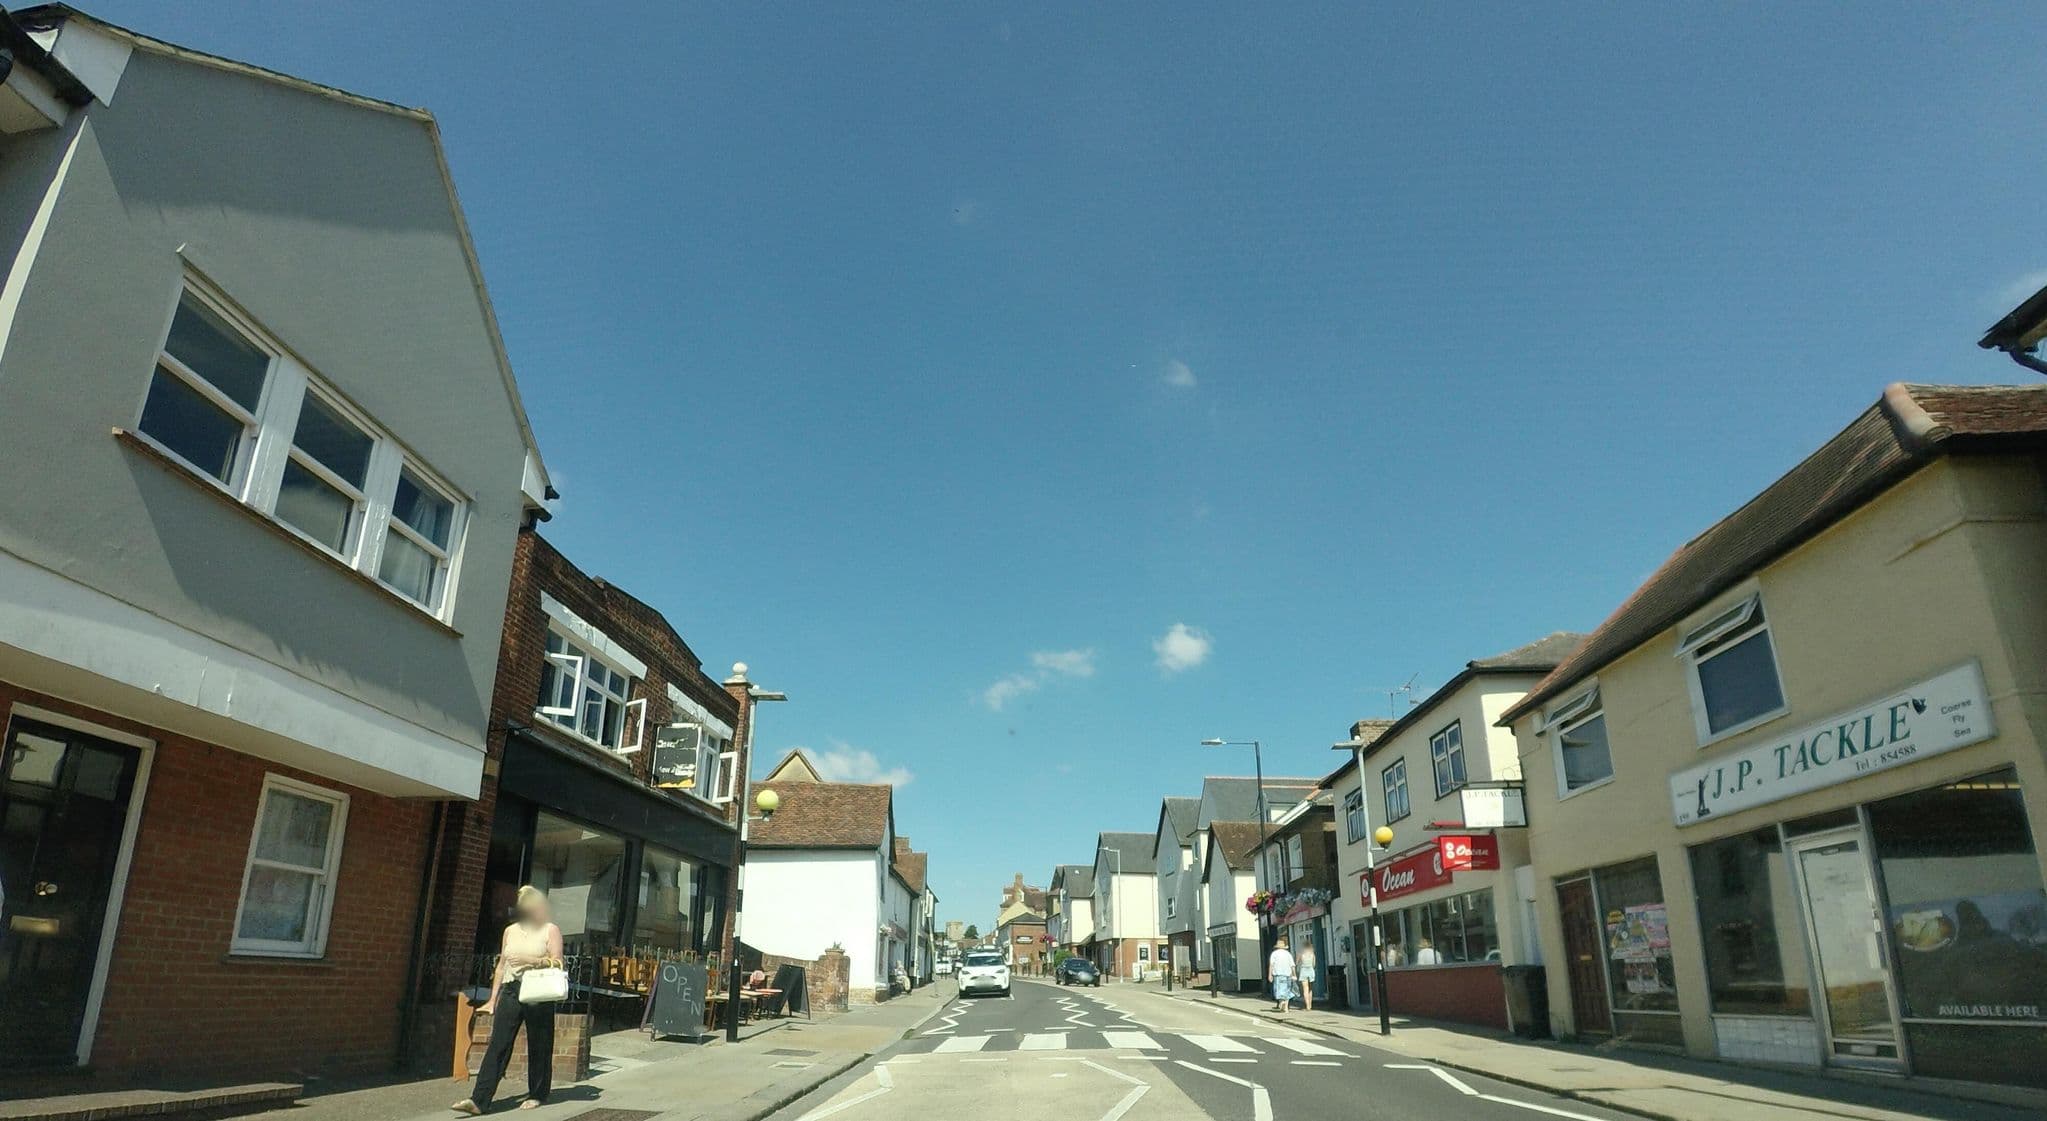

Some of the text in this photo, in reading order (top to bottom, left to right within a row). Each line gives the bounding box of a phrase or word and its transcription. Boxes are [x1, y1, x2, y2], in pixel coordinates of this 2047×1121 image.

[1712, 701, 1912, 799] J.P. TACKLE
[1382, 866, 1416, 893] Ocean
[663, 965, 701, 1016] OPEN
[1938, 1004, 2040, 1018] AVAILABLE HERE
